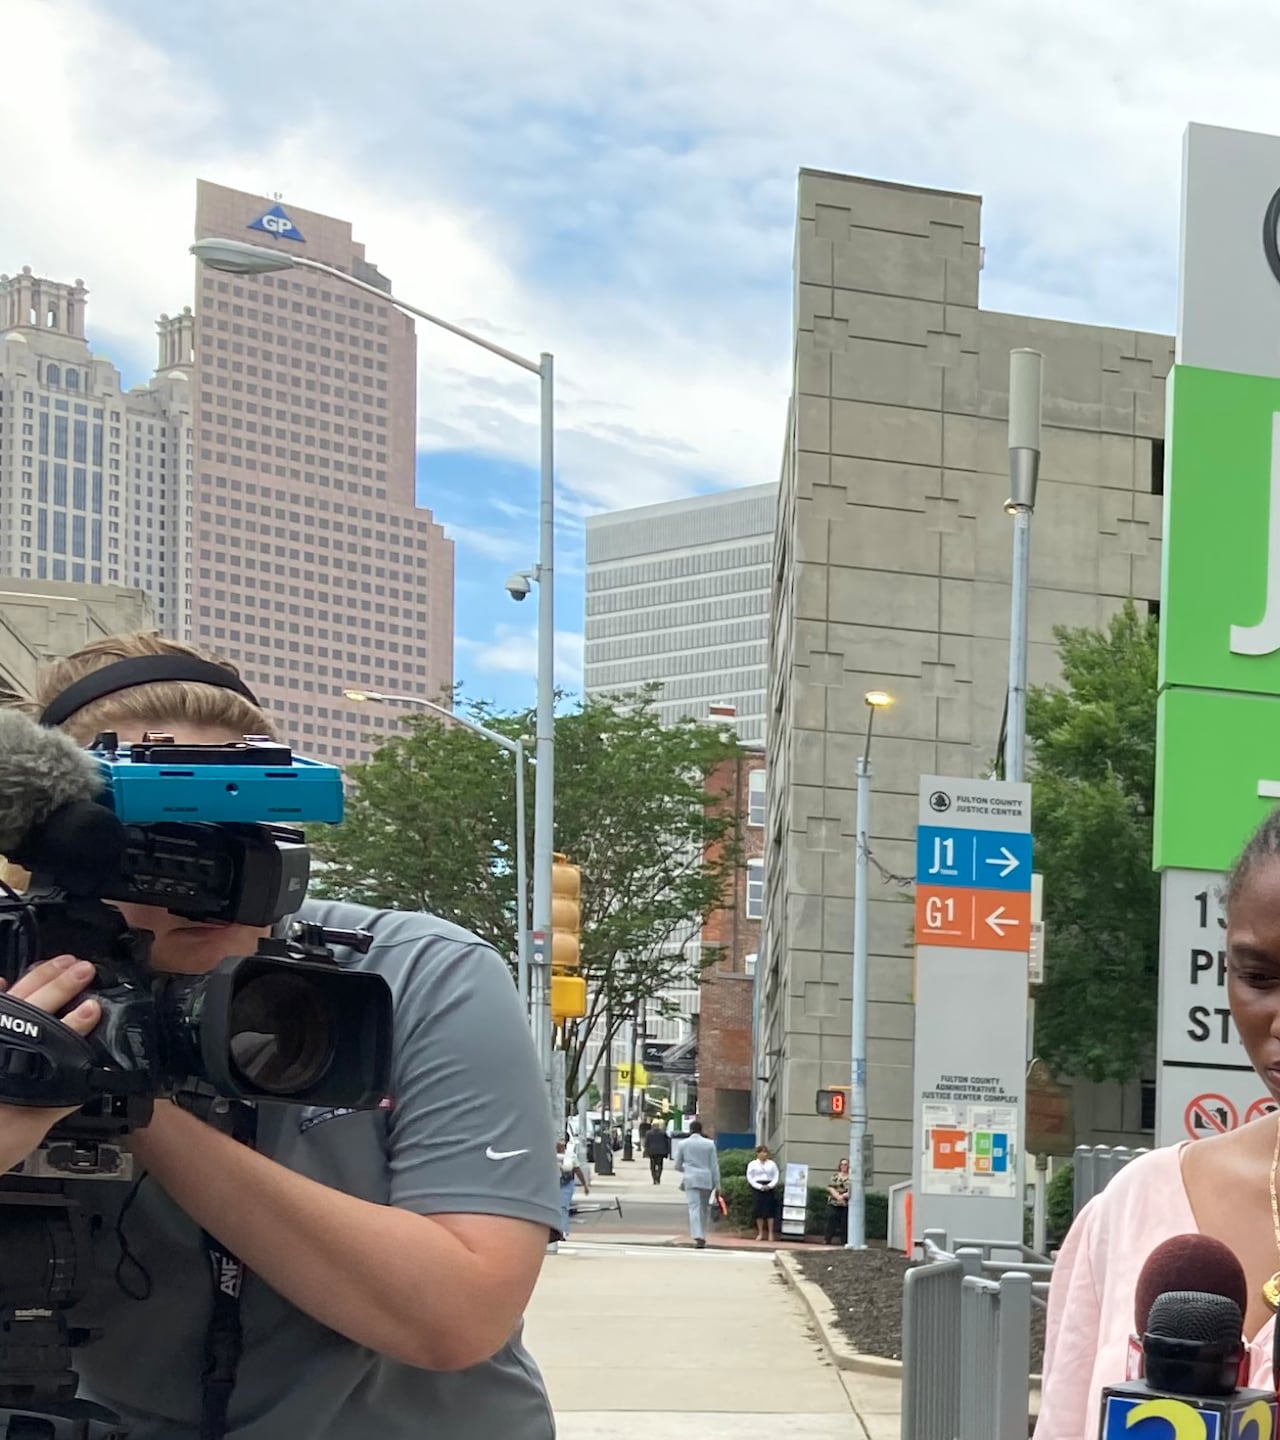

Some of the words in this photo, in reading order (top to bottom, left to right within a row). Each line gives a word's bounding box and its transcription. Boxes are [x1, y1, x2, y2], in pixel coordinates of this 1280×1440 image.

[262, 215, 292, 233] GP
[957, 795, 988, 804] FULTON
[990, 798, 1022, 807] COUNTY
[956, 805, 988, 814] JUSTICE
[991, 807, 1022, 816] CENTER
[928, 837, 954, 874] J1
[926, 896, 954, 928] G1
[941, 1075, 968, 1083] FULTON
[970, 1077, 1000, 1085] COUNTY
[936, 1083, 996, 1094] ADMINISTRATIVE
[921, 1091, 951, 1100] JUSTICE
[953, 1093, 982, 1101] CENTER
[984, 1095, 1018, 1103] COMPLEX
